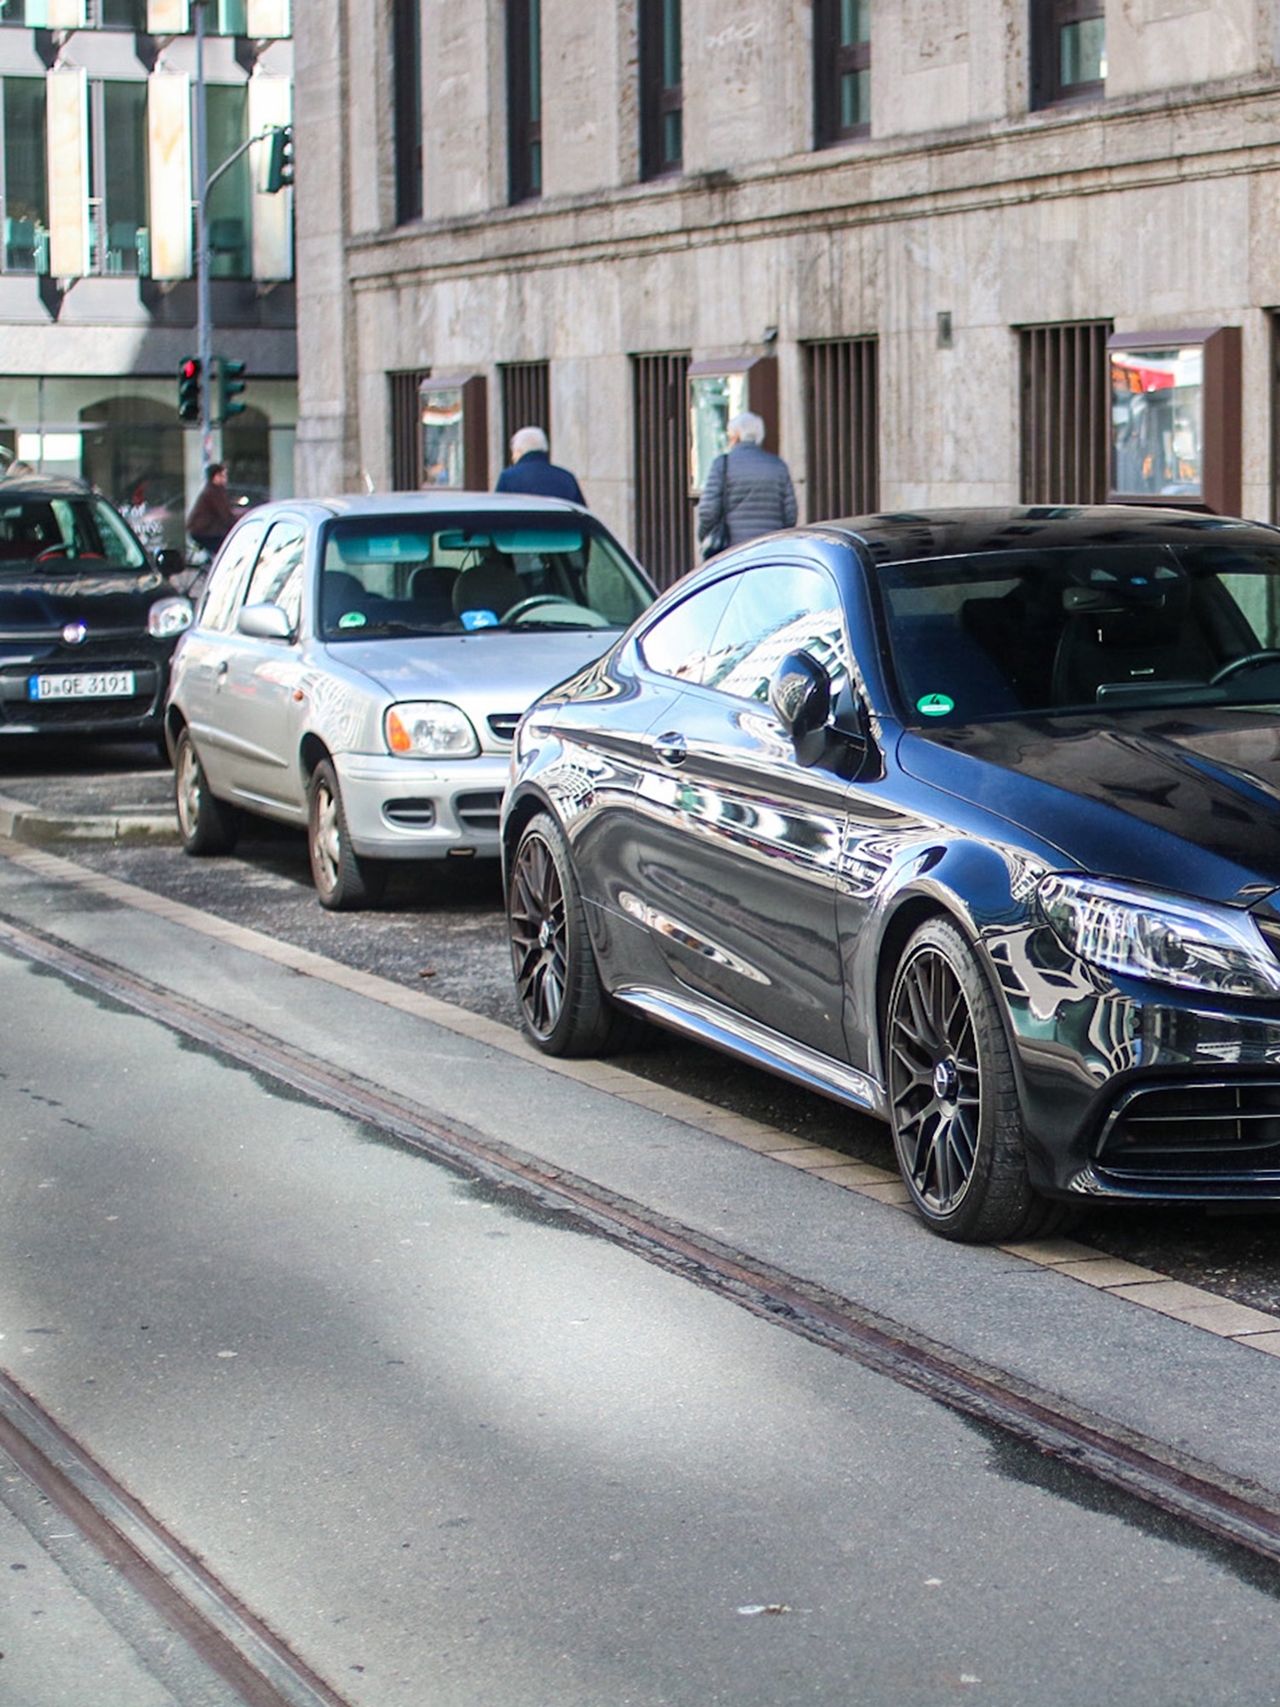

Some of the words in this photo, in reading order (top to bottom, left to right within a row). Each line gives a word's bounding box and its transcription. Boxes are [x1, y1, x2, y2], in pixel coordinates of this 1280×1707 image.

[41, 680, 51, 696] D
[62, 679, 82, 694] QE
[88, 677, 127, 692] 3191
